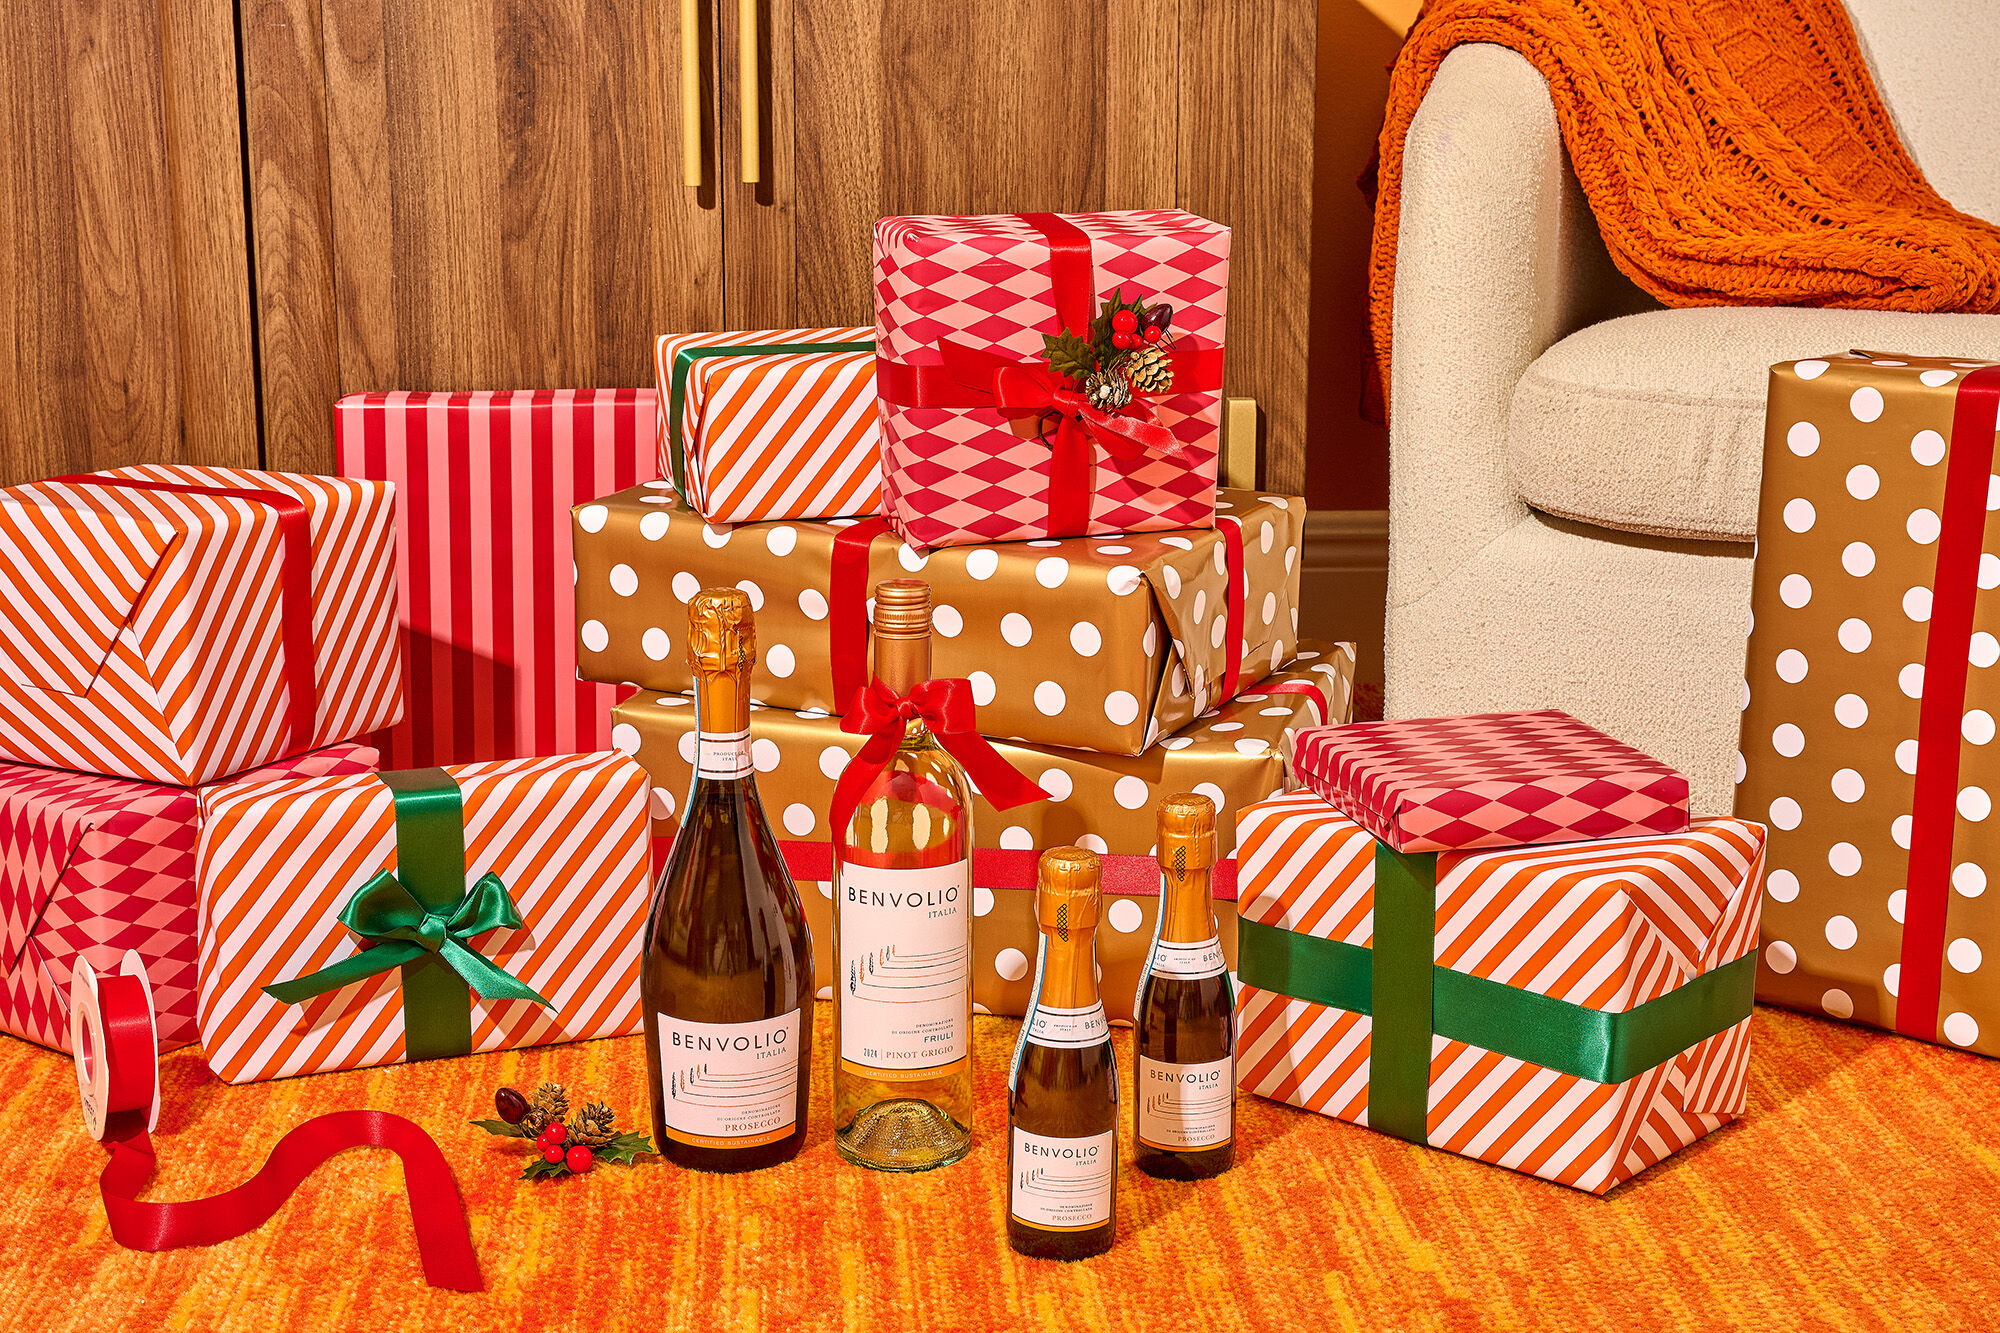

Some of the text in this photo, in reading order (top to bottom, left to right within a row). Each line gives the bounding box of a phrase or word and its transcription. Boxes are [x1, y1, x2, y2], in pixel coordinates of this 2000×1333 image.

[848, 886, 958, 909] BENVOLIO
[928, 906, 957, 919] ITALIA
[672, 1029, 787, 1051] BENVOLIO
[923, 1031, 954, 1044] FRIULI
[756, 1046, 787, 1060] ITALIA
[886, 1050, 918, 1060] PINOT
[921, 1045, 954, 1058] GRIGIO
[865, 1069, 943, 1079] CERTIFIED SUSTAINABLE
[1150, 1069, 1219, 1083] BENVOLIO
[725, 1116, 781, 1131] PROSECCO
[691, 1135, 771, 1146] CERTIFIED SUSTAINABLE
[1177, 1134, 1215, 1142] PROSECCO
[1024, 1142, 1098, 1158] BENVOLIO
[1052, 1213, 1092, 1221] PROSECCO
